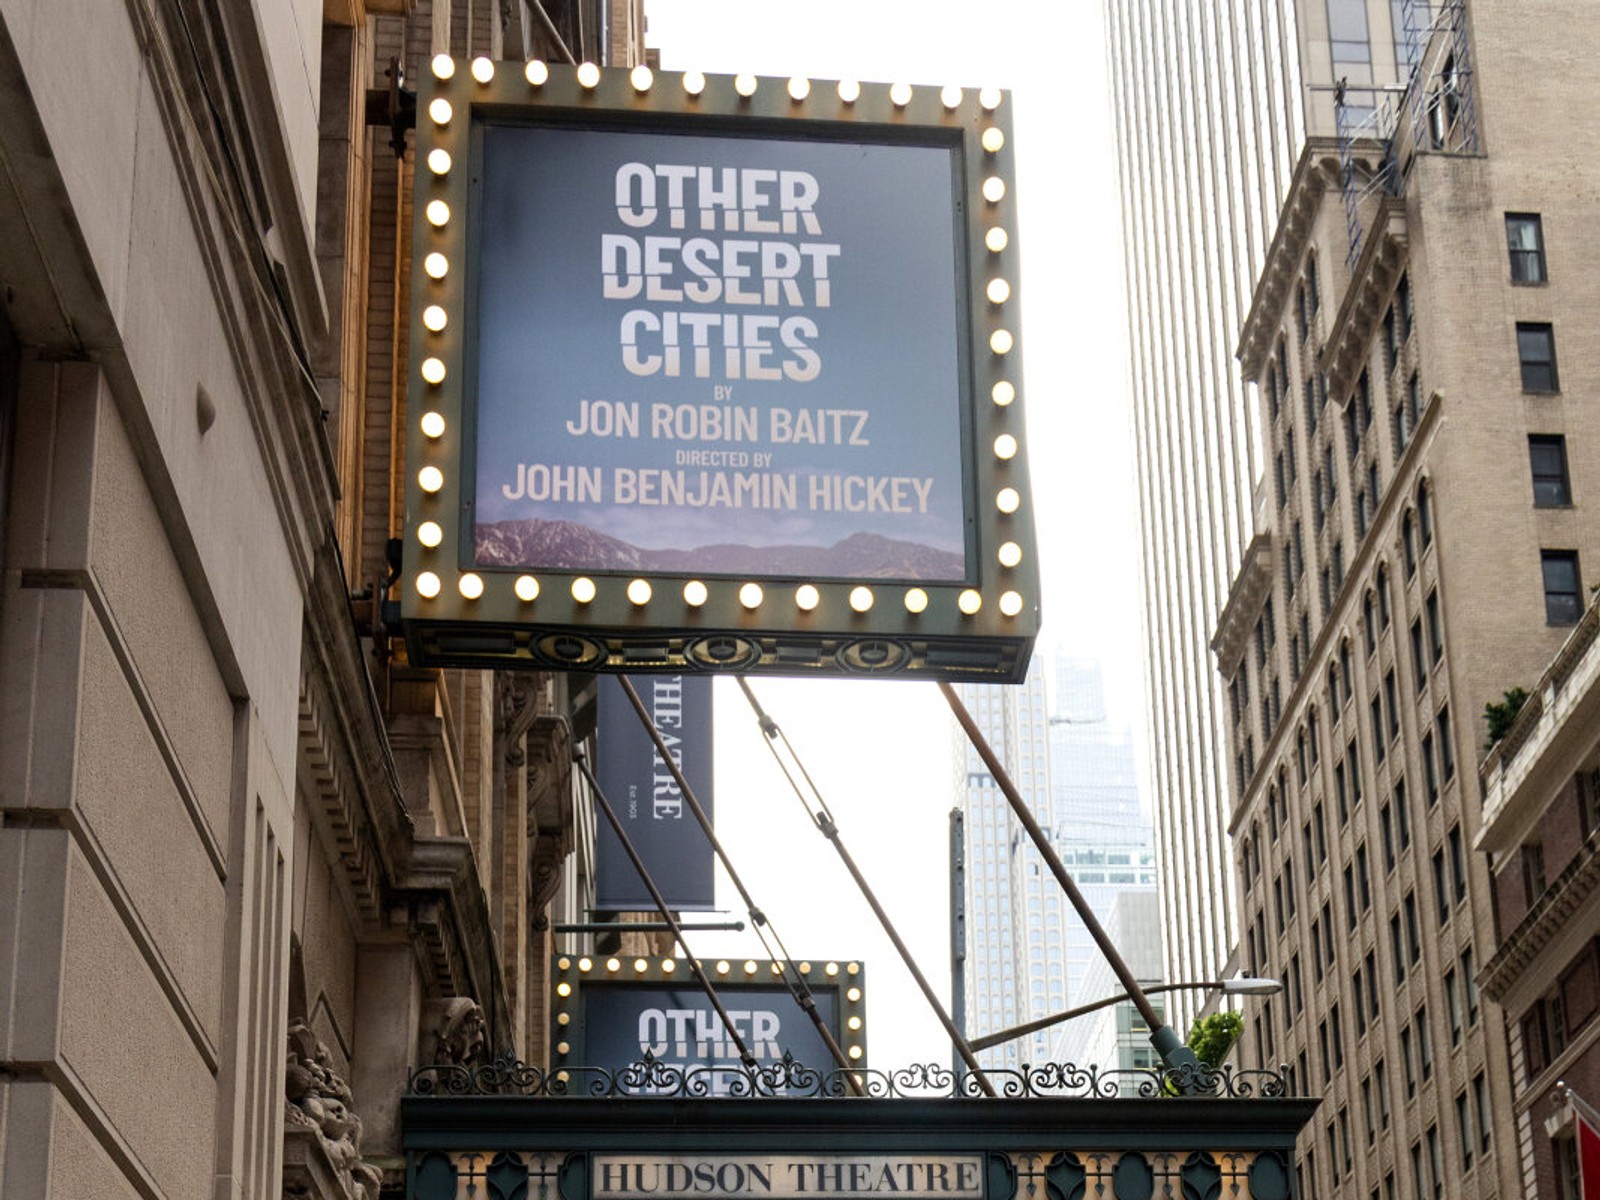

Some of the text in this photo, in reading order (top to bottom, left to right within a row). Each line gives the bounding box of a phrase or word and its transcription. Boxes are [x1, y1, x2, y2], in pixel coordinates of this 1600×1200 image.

[615, 162, 823, 236] OTHER
[601, 234, 841, 308] DESERT
[620, 310, 823, 383] CITIES
[713, 385, 733, 401] BY
[565, 399, 870, 447] JON ROBIN BAITZ
[675, 450, 773, 468] DIRECTED BY
[502, 463, 935, 514] JOHN BENJAMIN HICKEY
[652, 675, 683, 820] HEATRE
[638, 1008, 782, 1059] OTHER
[600, 1161, 981, 1193] HUDSON THEATRE
